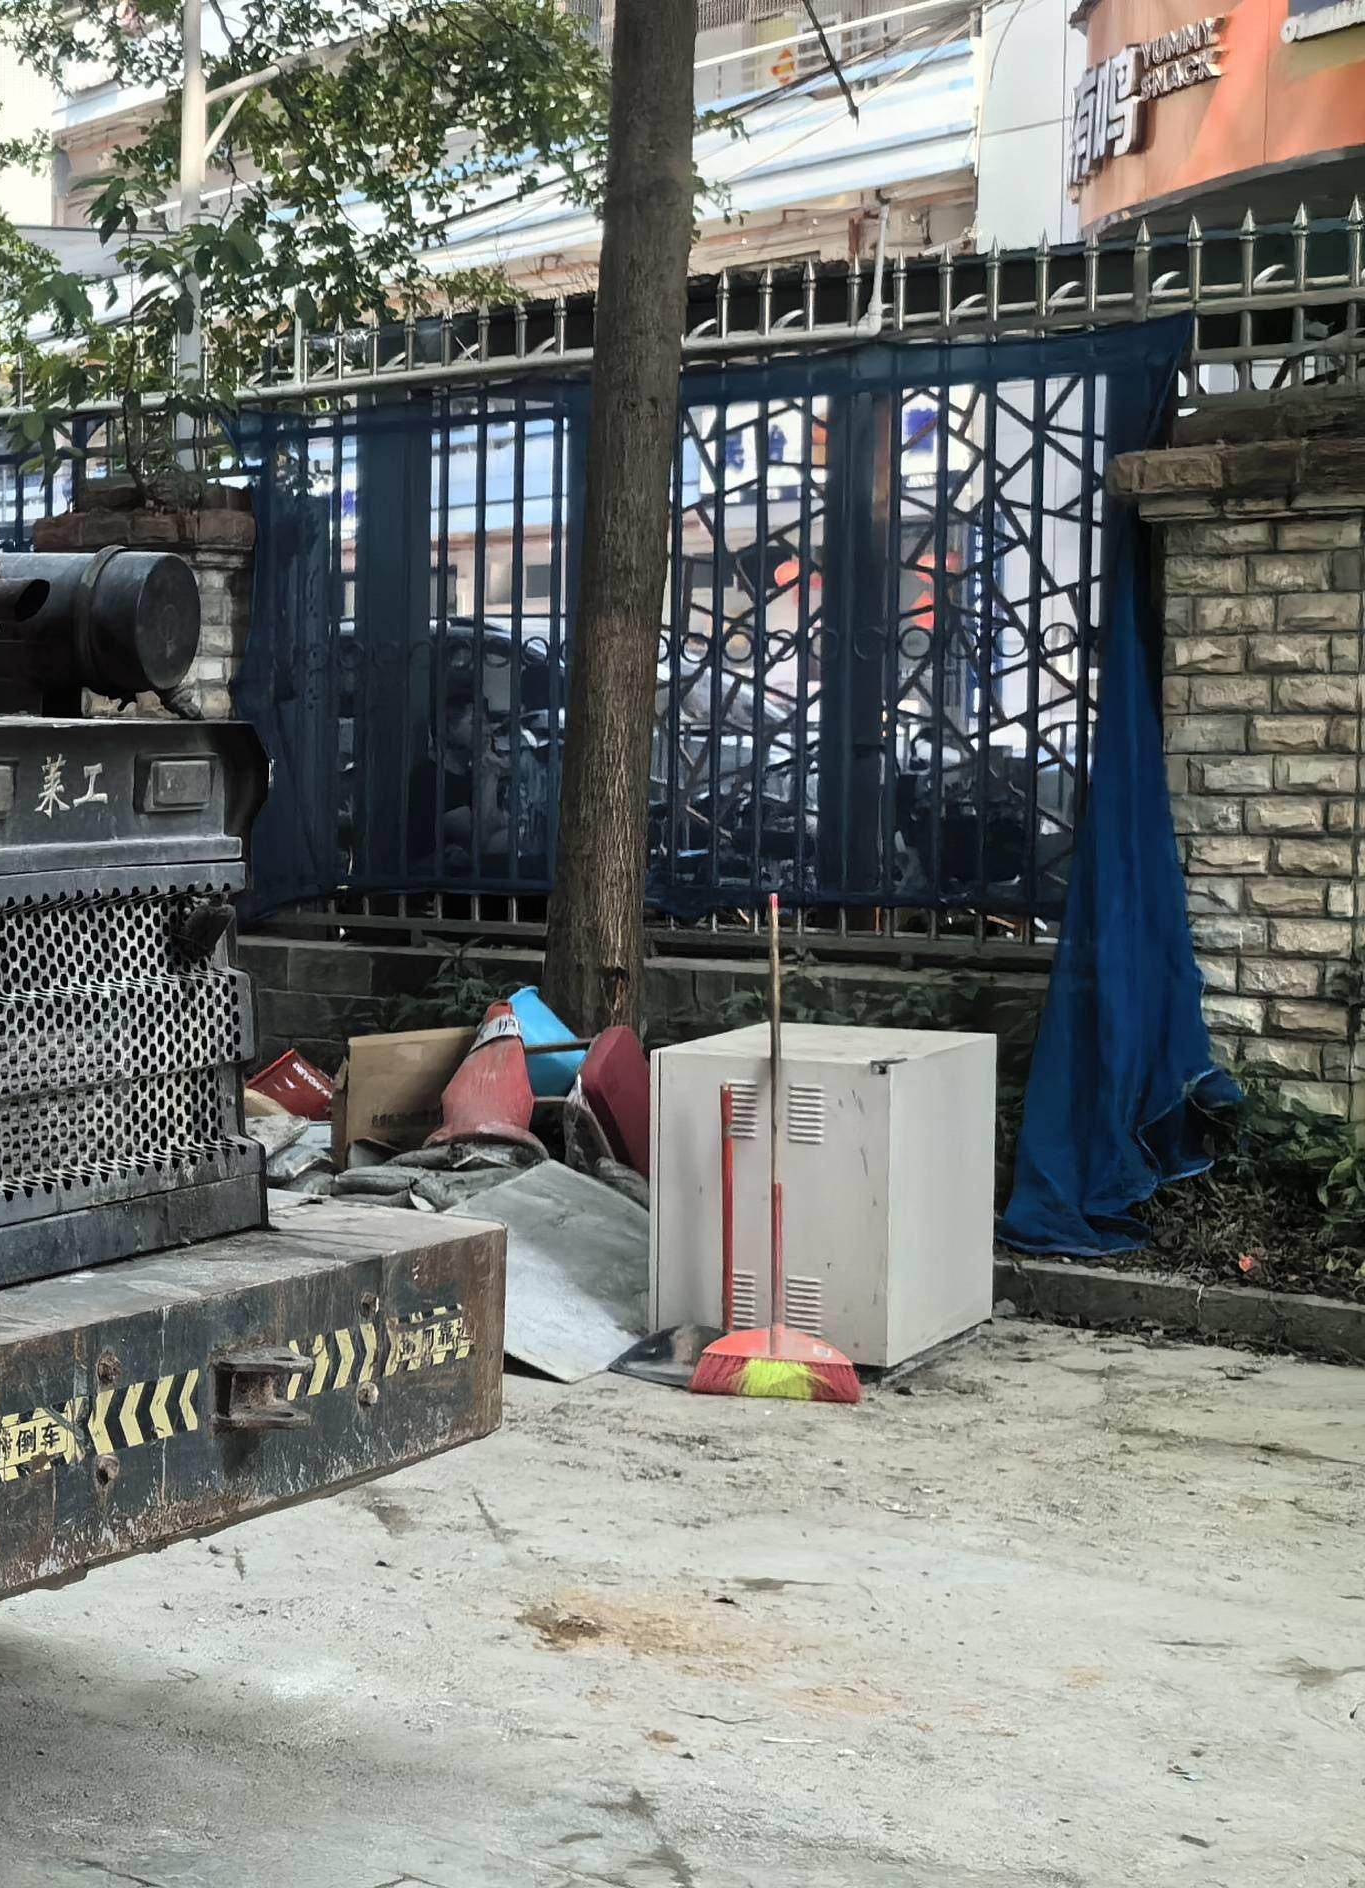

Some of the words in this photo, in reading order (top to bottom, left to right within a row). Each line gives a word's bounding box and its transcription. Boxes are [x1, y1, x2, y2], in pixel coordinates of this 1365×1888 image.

[1141, 15, 1223, 69] YUMMY
[1140, 50, 1222, 101] SNACK
[34, 753, 109, 819] 莱工
